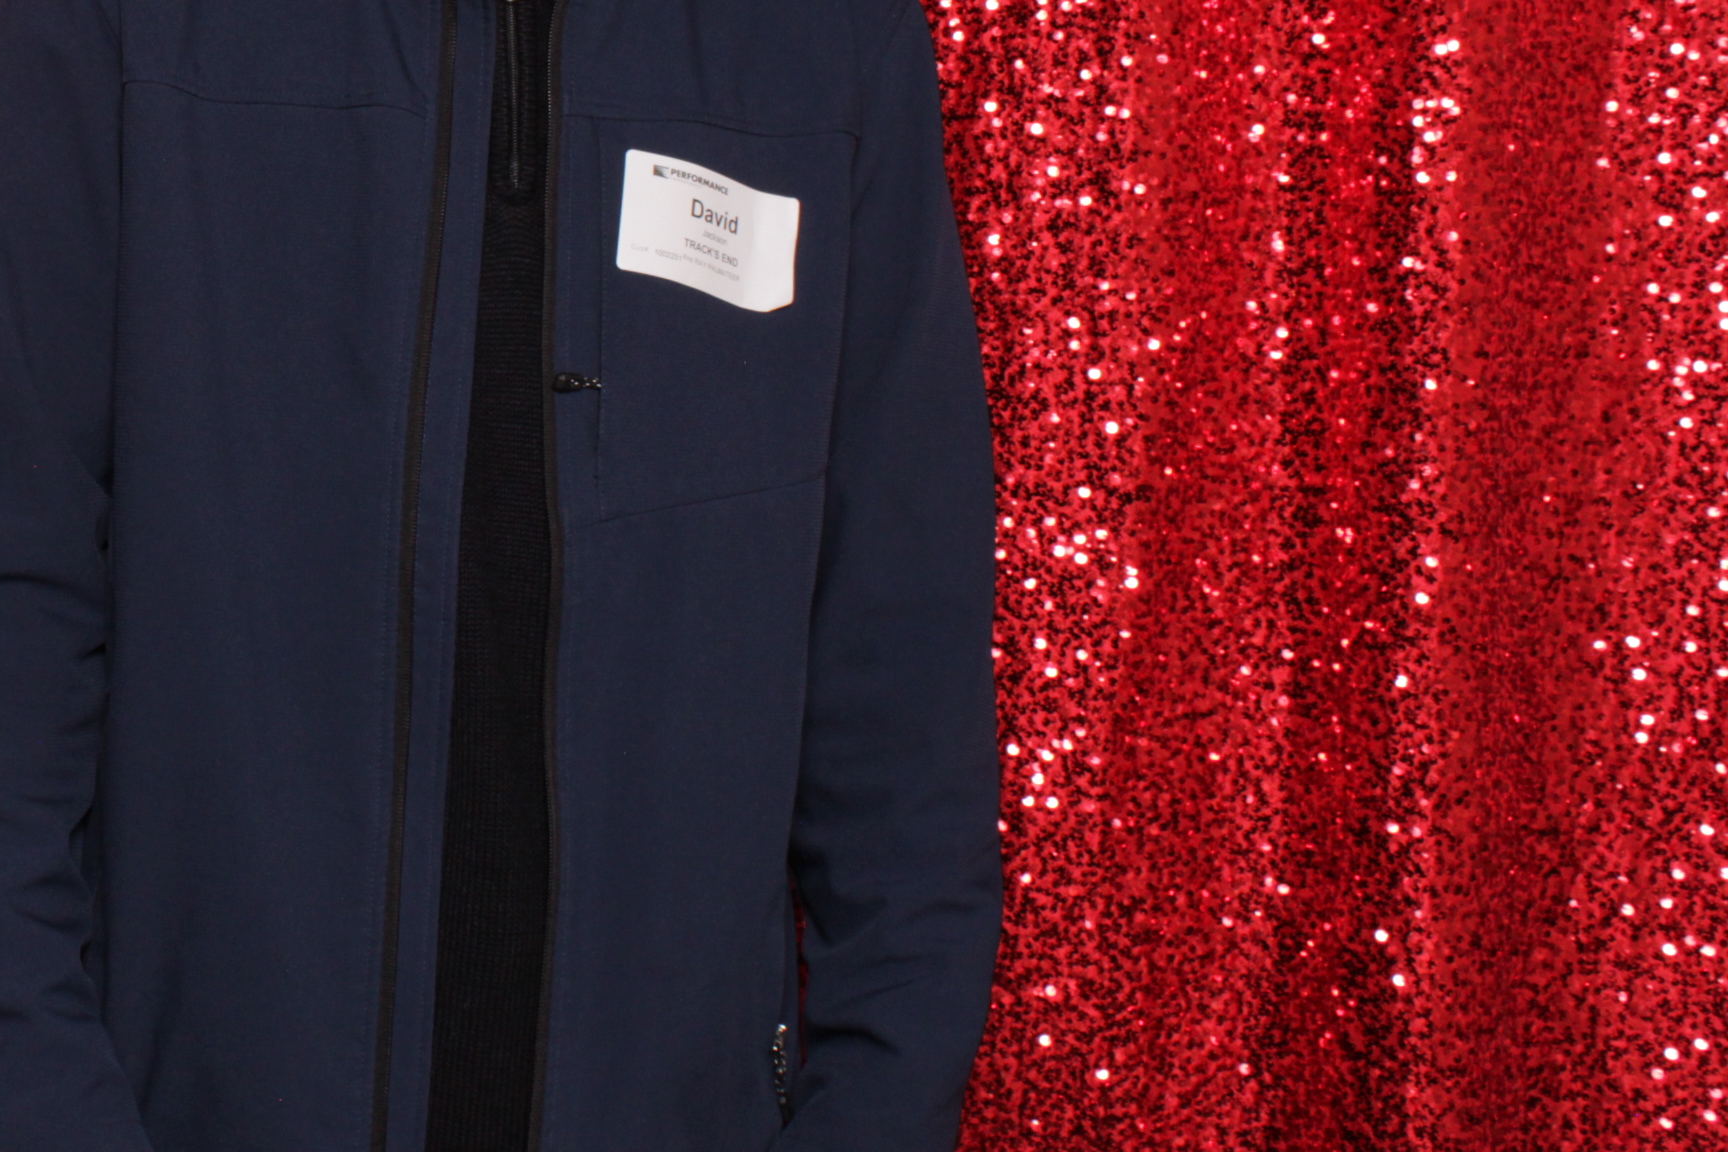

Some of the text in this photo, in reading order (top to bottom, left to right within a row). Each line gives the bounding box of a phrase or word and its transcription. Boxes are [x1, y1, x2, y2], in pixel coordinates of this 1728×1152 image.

[670, 168, 729, 196] PERFORMANCE
[690, 198, 739, 235] David
[684, 238, 739, 268] TRACK'S END
